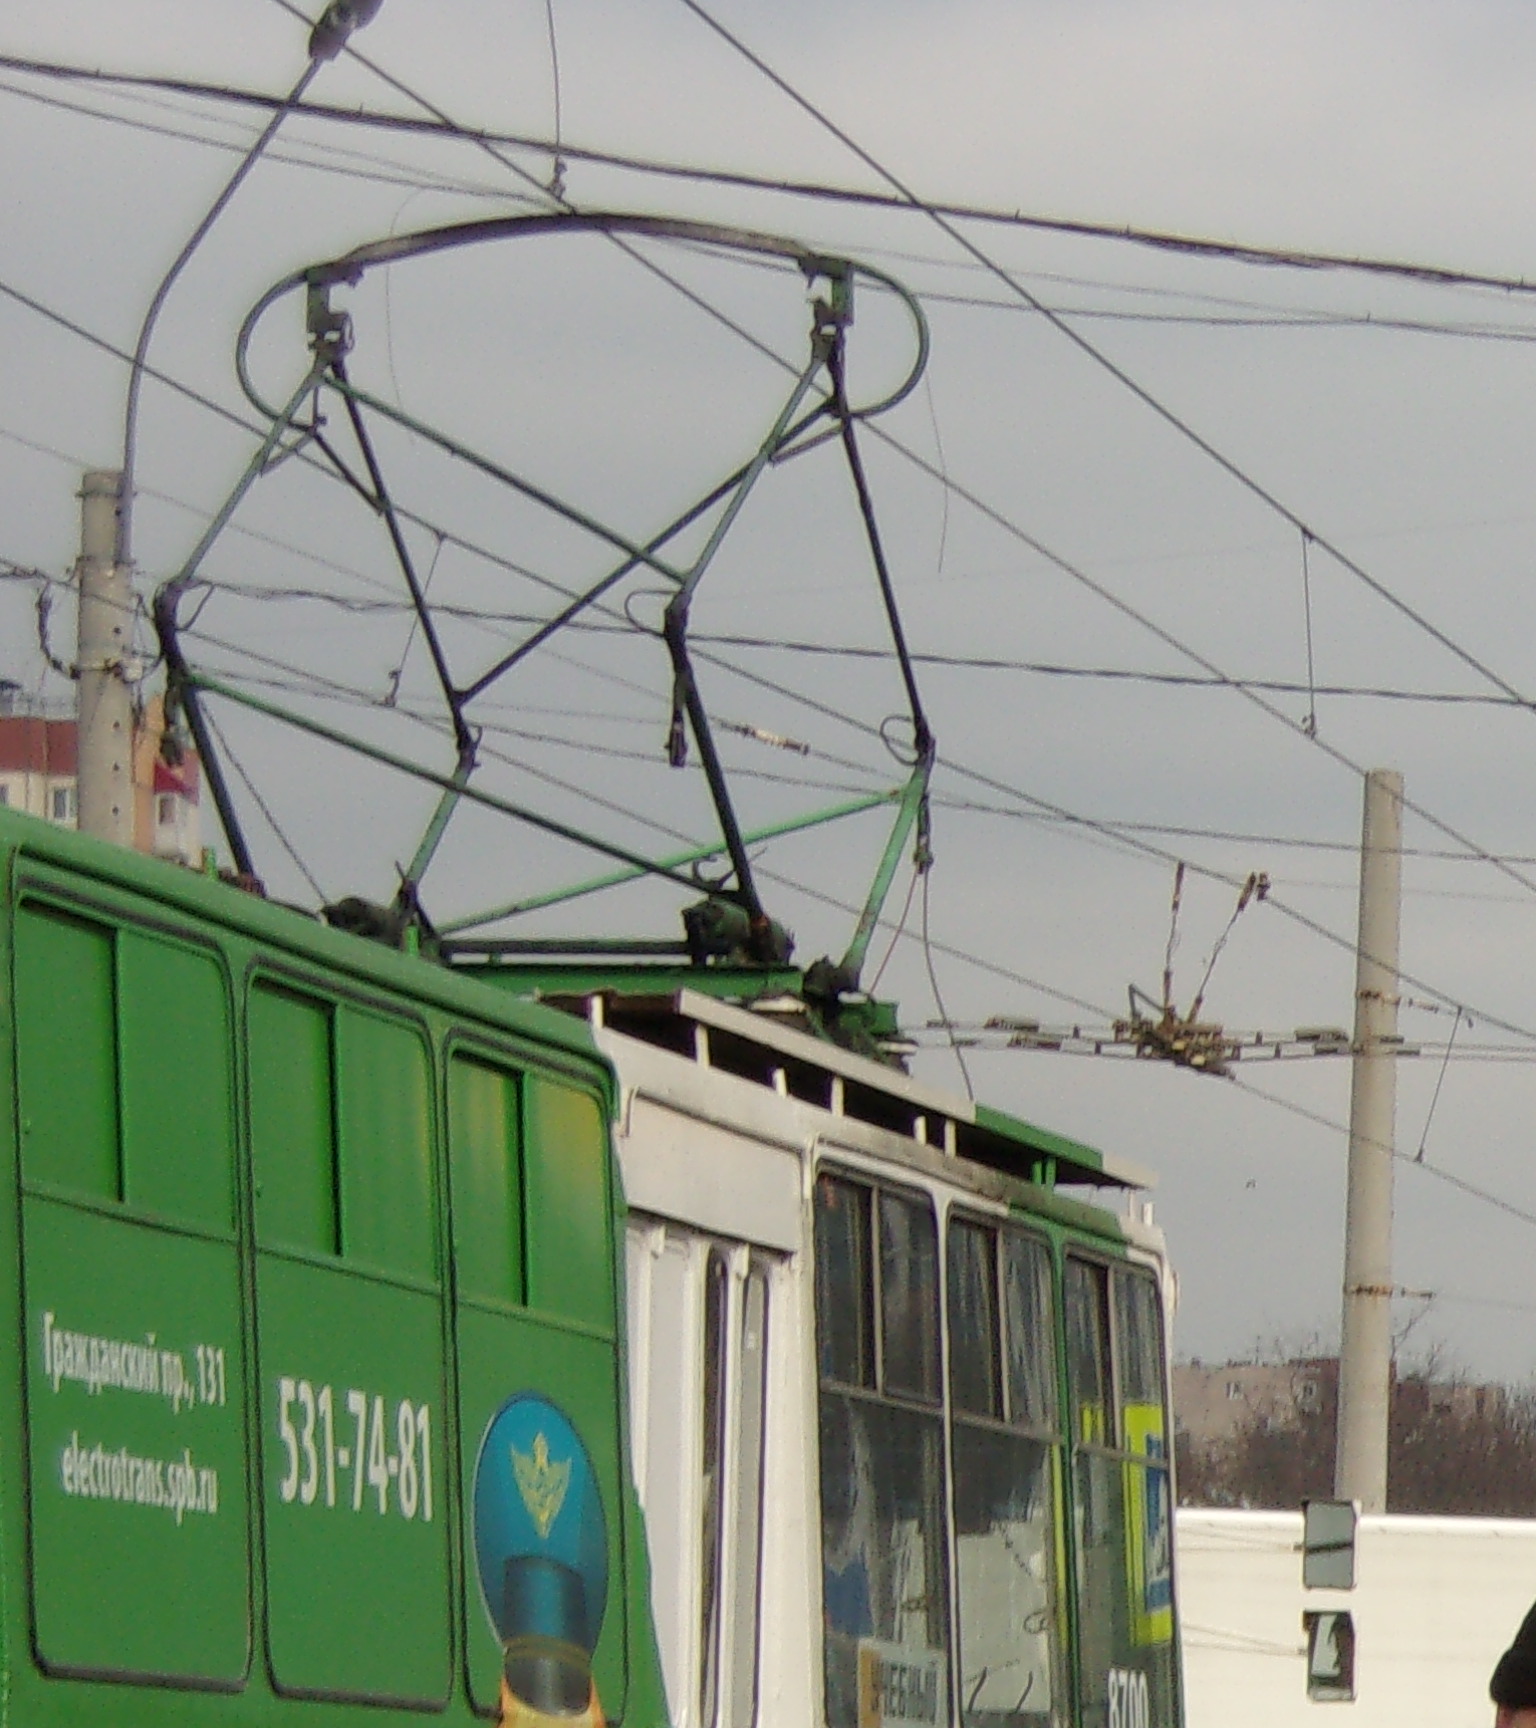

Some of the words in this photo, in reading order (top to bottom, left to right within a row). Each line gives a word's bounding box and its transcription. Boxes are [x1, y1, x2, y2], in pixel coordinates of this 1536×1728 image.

[197, 1344, 226, 1407] 131
[62, 1430, 219, 1526] electrotrans.spb.ru
[279, 1376, 433, 1522] 531-74-81
